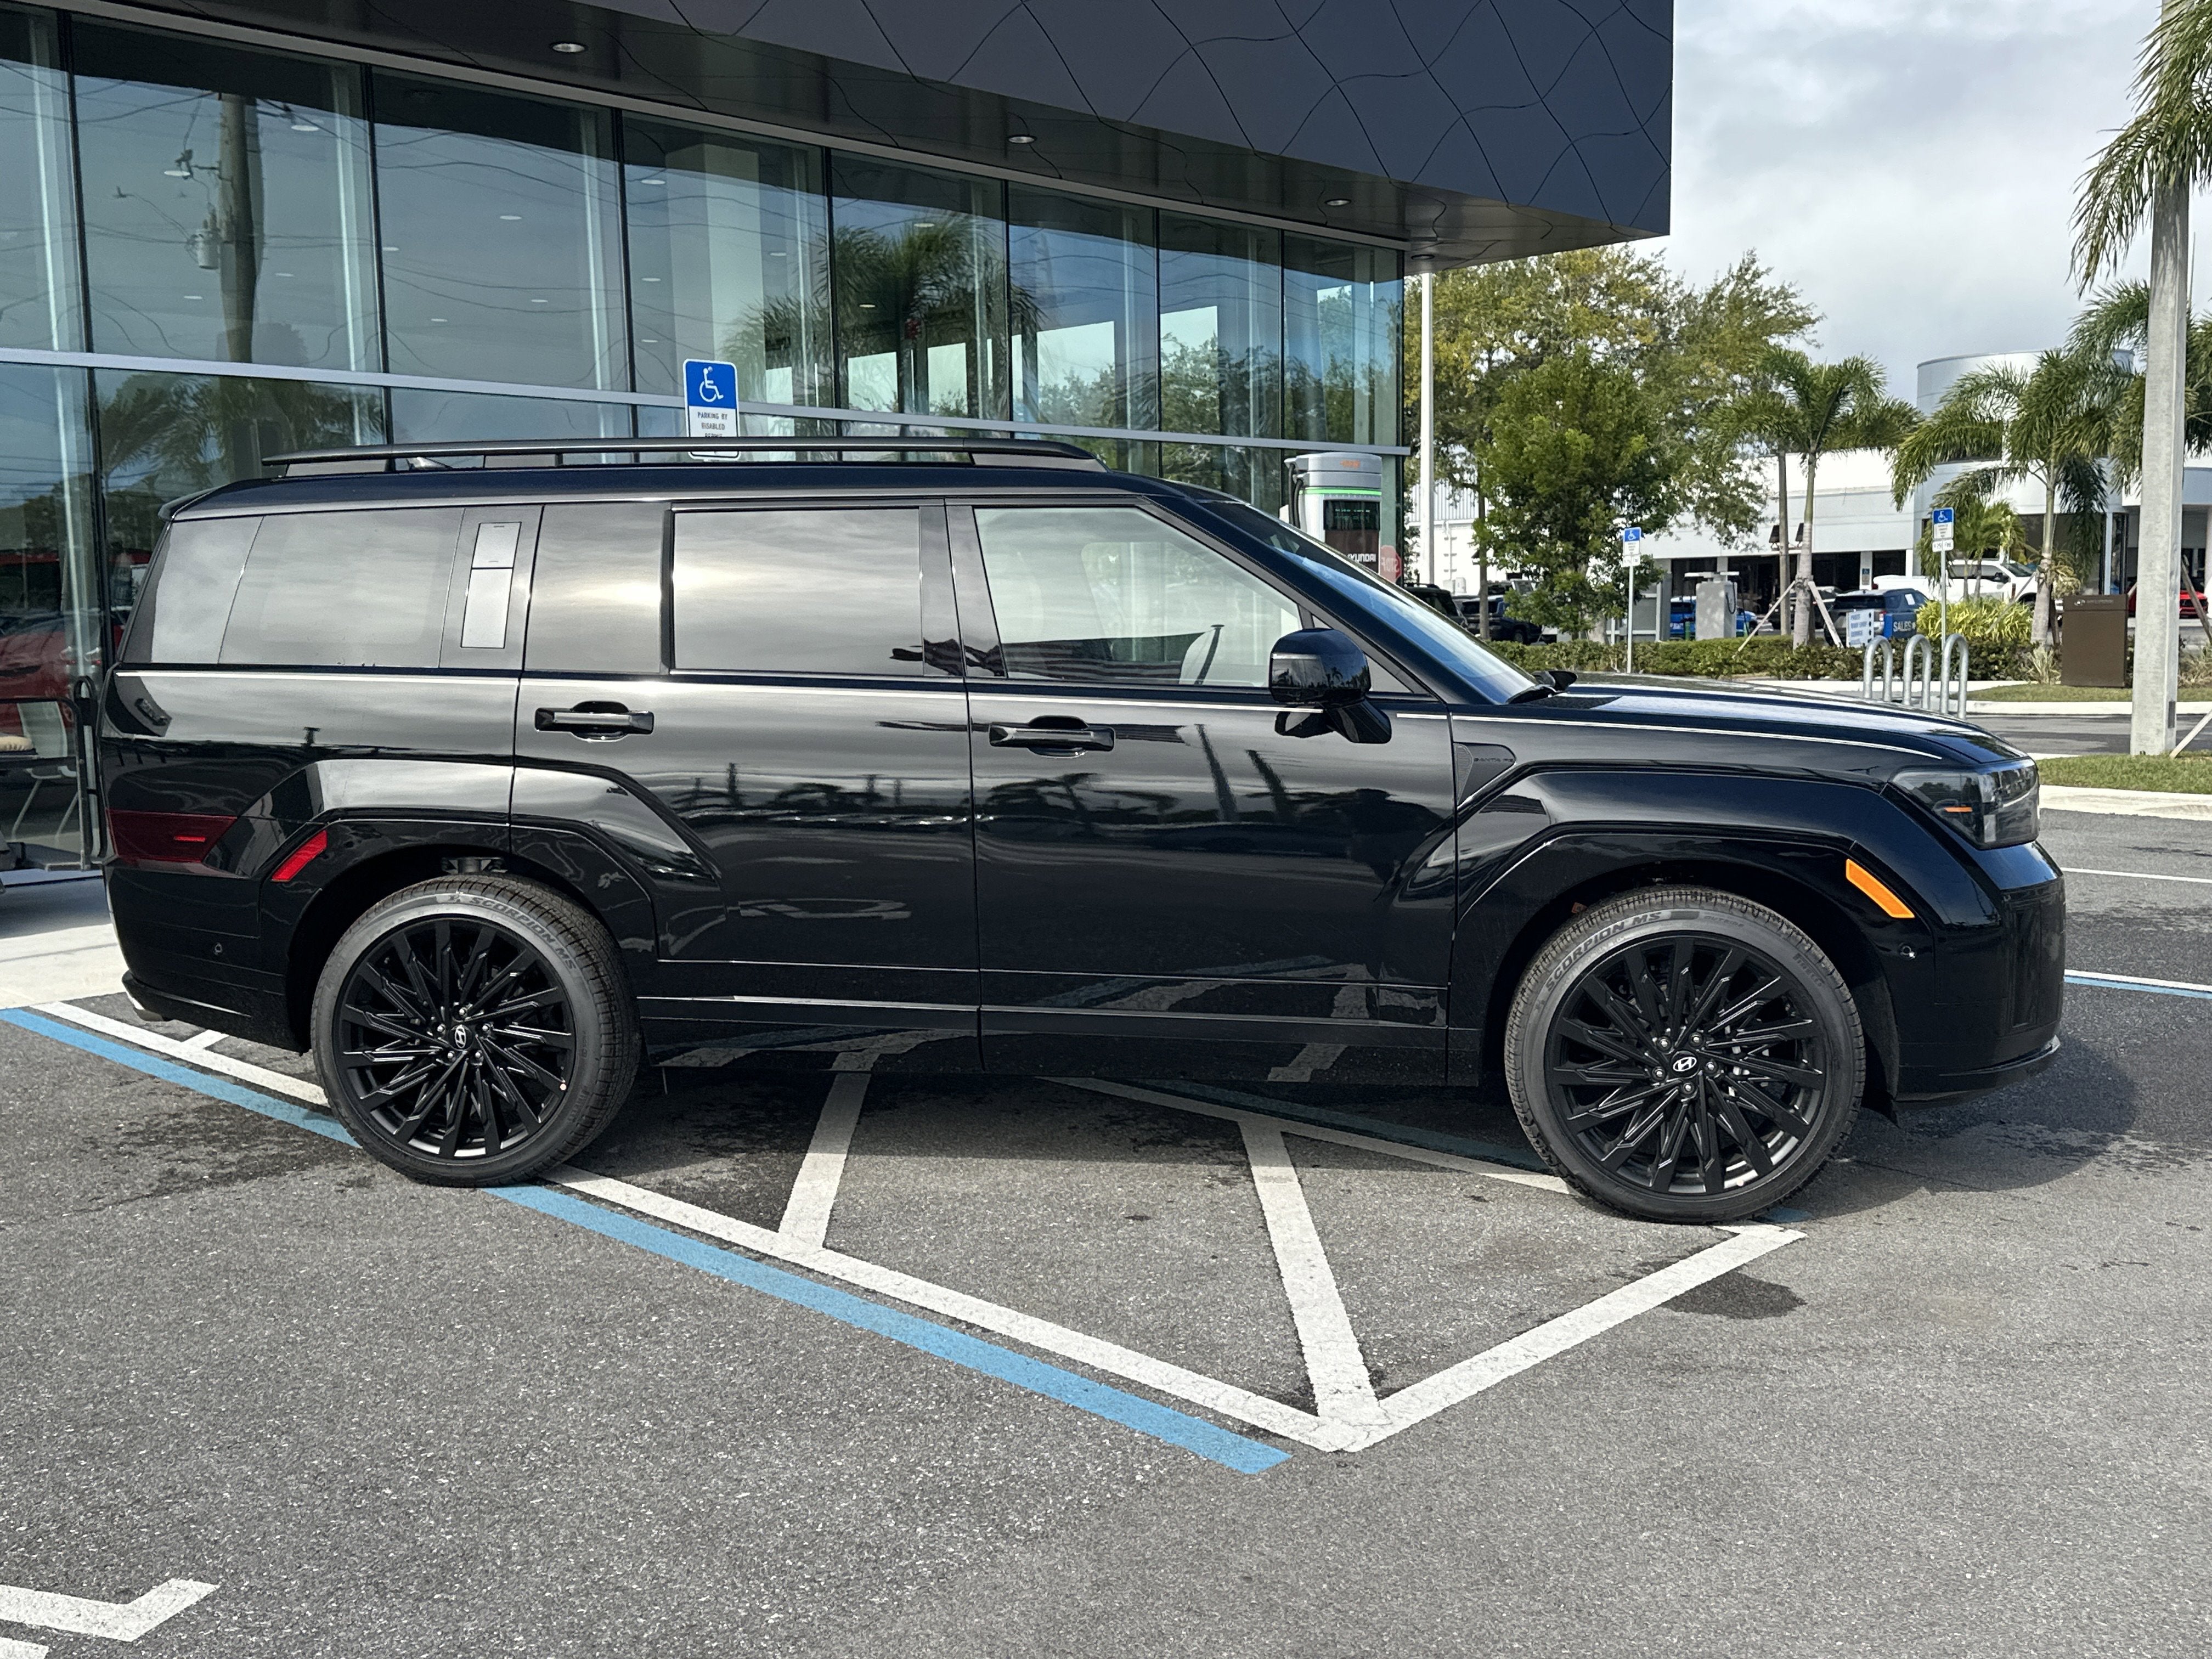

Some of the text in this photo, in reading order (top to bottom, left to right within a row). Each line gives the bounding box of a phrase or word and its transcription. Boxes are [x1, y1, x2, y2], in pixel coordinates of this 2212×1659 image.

[1893, 621, 1911, 632] SALES
[470, 897, 576, 969] SCORPION MS
[1545, 912, 1662, 992] SCORPION MS
